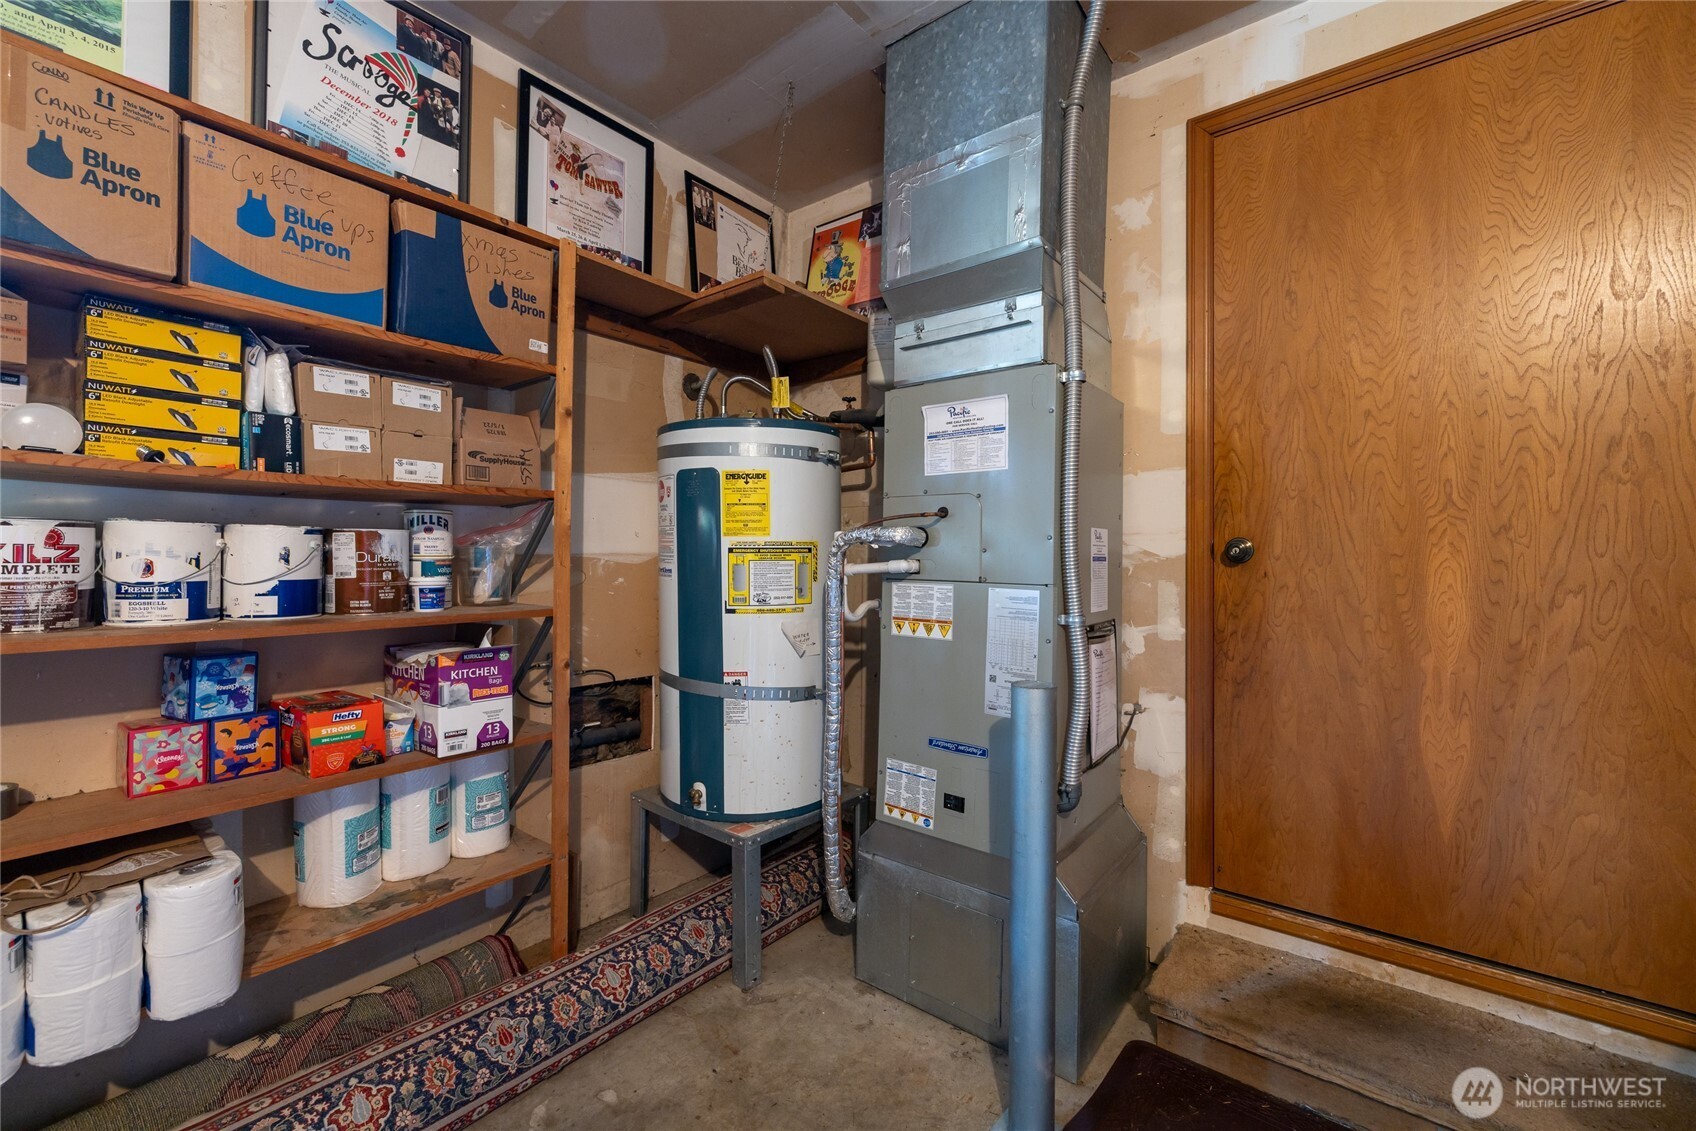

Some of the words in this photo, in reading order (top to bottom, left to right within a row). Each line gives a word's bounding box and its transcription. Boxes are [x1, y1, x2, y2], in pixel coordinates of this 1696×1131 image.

[14, 10, 34, 22] and
[40, 20, 66, 34] April
[69, 30, 78, 40] 3,
[80, 36, 90, 44] 4,
[93, 40, 116, 54] 2015
[302, 23, 418, 108] Scrooge
[325, 64, 339, 76] THE
[340, 73, 372, 96] MUSICAL
[320, 76, 372, 110] December
[372, 108, 398, 126] 2018
[34, 87, 136, 136] CANDLES
[123, 100, 138, 110] This
[139, 105, 154, 117] Way
[155, 112, 165, 121] Up
[123, 106, 153, 122] Perishable
[144, 120, 157, 129] With
[83, 146, 141, 182] Blue
[232, 154, 335, 207] Coffee
[556, 154, 578, 181] TOM
[584, 173, 623, 199] SAWYER
[80, 168, 161, 208] Apron
[284, 204, 334, 237] Blue
[282, 225, 351, 262] Apron
[512, 286, 537, 304] Blue
[90, 299, 133, 313] NUWATT
[511, 300, 546, 320] Apron
[90, 341, 133, 354] NUWATT
[88, 382, 132, 394] NUWATT
[88, 392, 100, 400] 6"
[947, 406, 971, 418] Pacific
[88, 424, 132, 434] NUWATT
[88, 434, 100, 442] 6"
[285, 424, 293, 455] ecosmart
[356, 552, 396, 563] Dura
[1, 565, 80, 575] MPLETE
[121, 585, 170, 593] PREMIUM
[464, 652, 494, 660] KIRKLAND
[392, 663, 425, 681] KITCHEN
[451, 666, 498, 680] KITCHEN
[215, 683, 239, 691] Kleenex
[334, 711, 361, 721] Hefty
[322, 724, 357, 735] STRONG
[423, 724, 432, 739] 13
[486, 723, 500, 735] 13
[233, 741, 260, 751] Kleenex
[492, 739, 506, 747] BAGS
[154, 754, 184, 765] Kleenex
